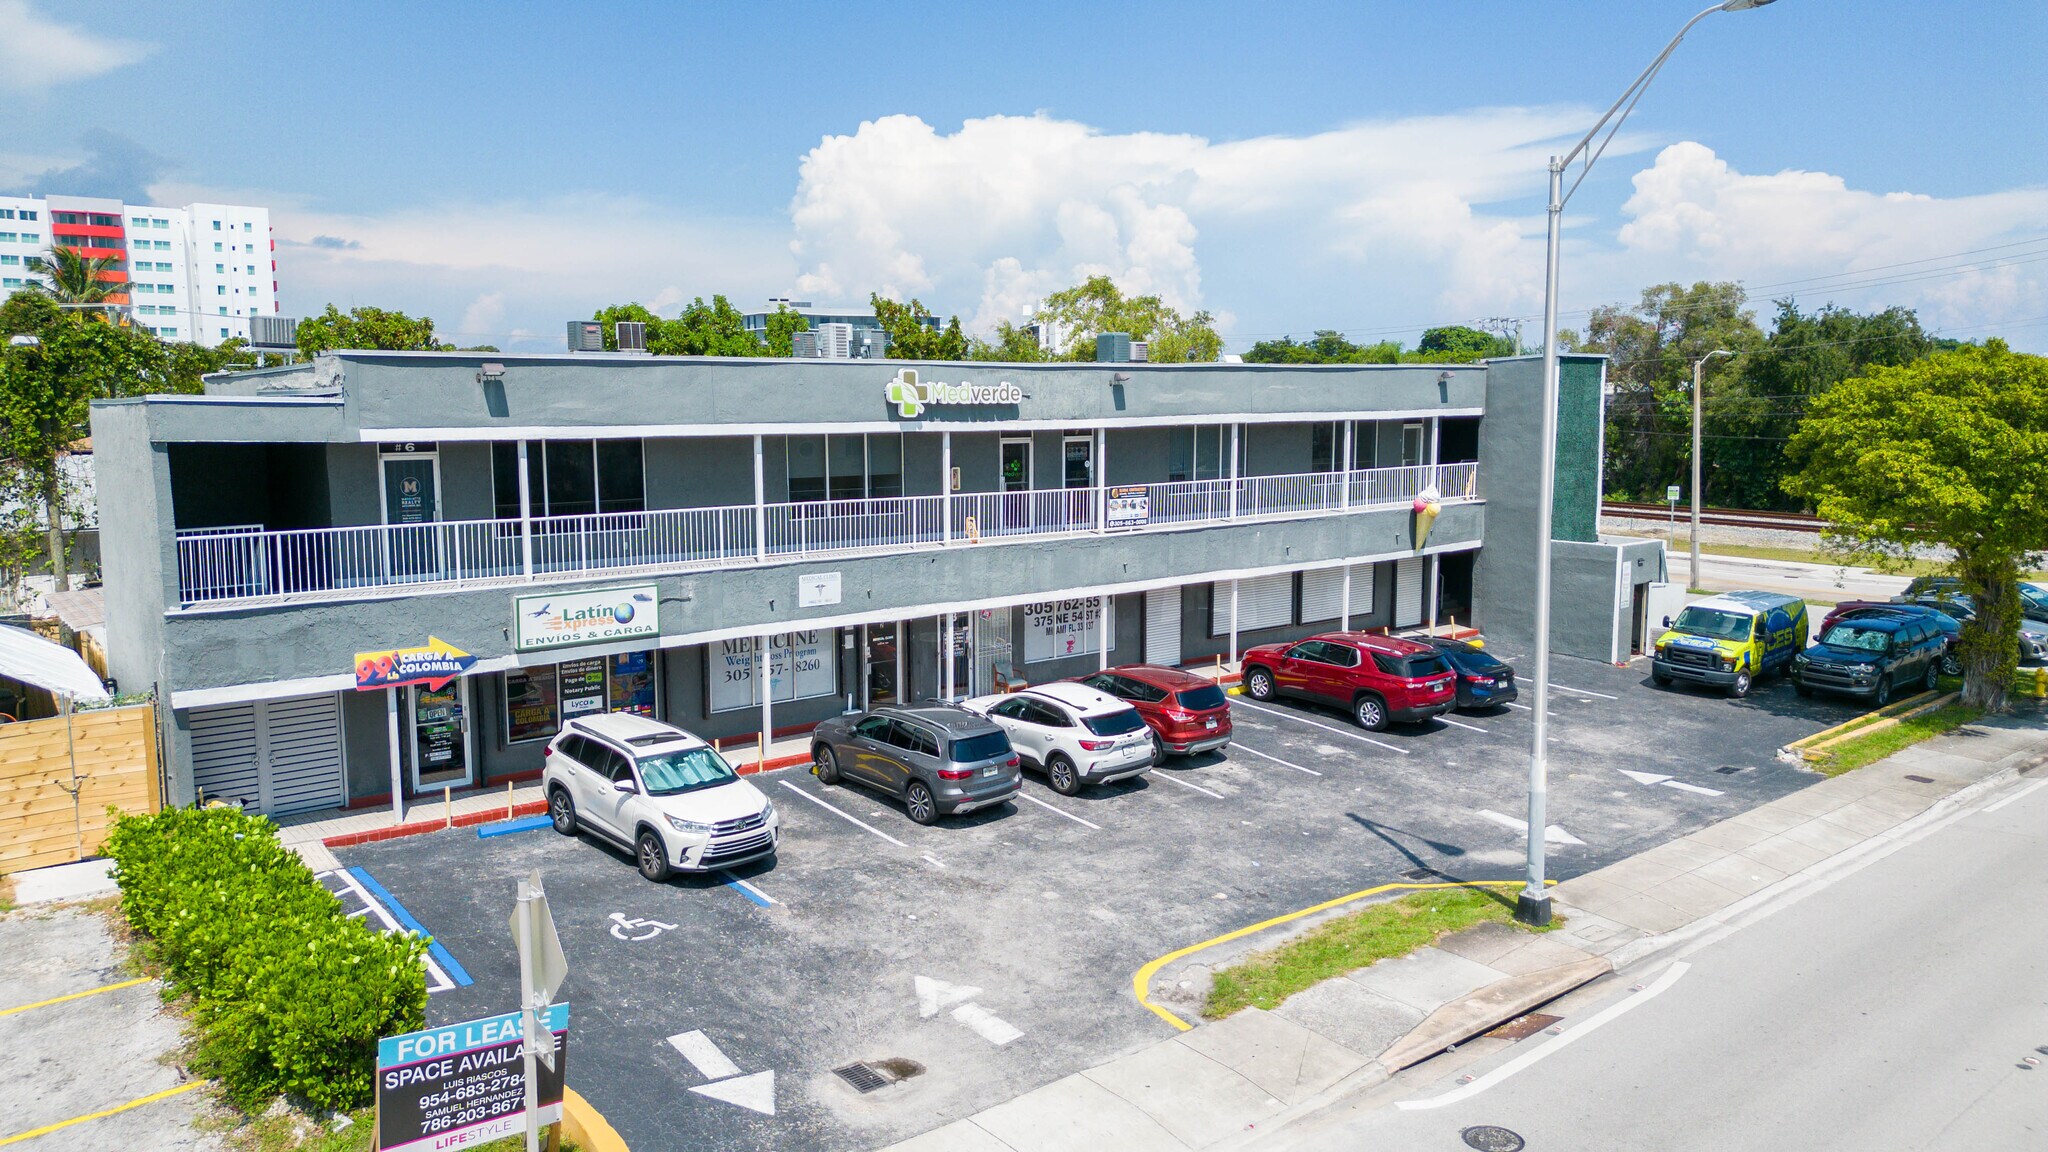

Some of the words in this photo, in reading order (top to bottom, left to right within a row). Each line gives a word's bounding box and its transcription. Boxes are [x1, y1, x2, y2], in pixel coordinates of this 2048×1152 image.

[932, 383, 1020, 402] Medverde
[403, 480, 418, 493] M
[1025, 602, 1053, 616] 305
[1034, 615, 1053, 628] 375
[1056, 612, 1069, 624] NE
[1071, 611, 1083, 622] 54
[1086, 609, 1094, 621] ST
[604, 625, 653, 637] CARGA
[401, 651, 442, 663] CARGA
[445, 651, 455, 660] A
[784, 647, 817, 660] Program
[399, 661, 463, 674] COLOMBIA
[724, 667, 751, 684] 305
[564, 687, 584, 695] Notary
[571, 700, 589, 708] Lyca
[397, 1030, 456, 1062] FOR
[465, 1010, 552, 1048] LEAE
[385, 1059, 453, 1090] SPACE
[458, 1035, 562, 1074] AVAILAE
[443, 1078, 465, 1090] LUIS
[466, 1068, 508, 1086] RIASCOS
[419, 1072, 527, 1110] 954-683-2784
[425, 1103, 464, 1119] SAMUEL
[466, 1087, 523, 1107] HERNANDEZ
[435, 1119, 512, 1150] LIFESTYLE
